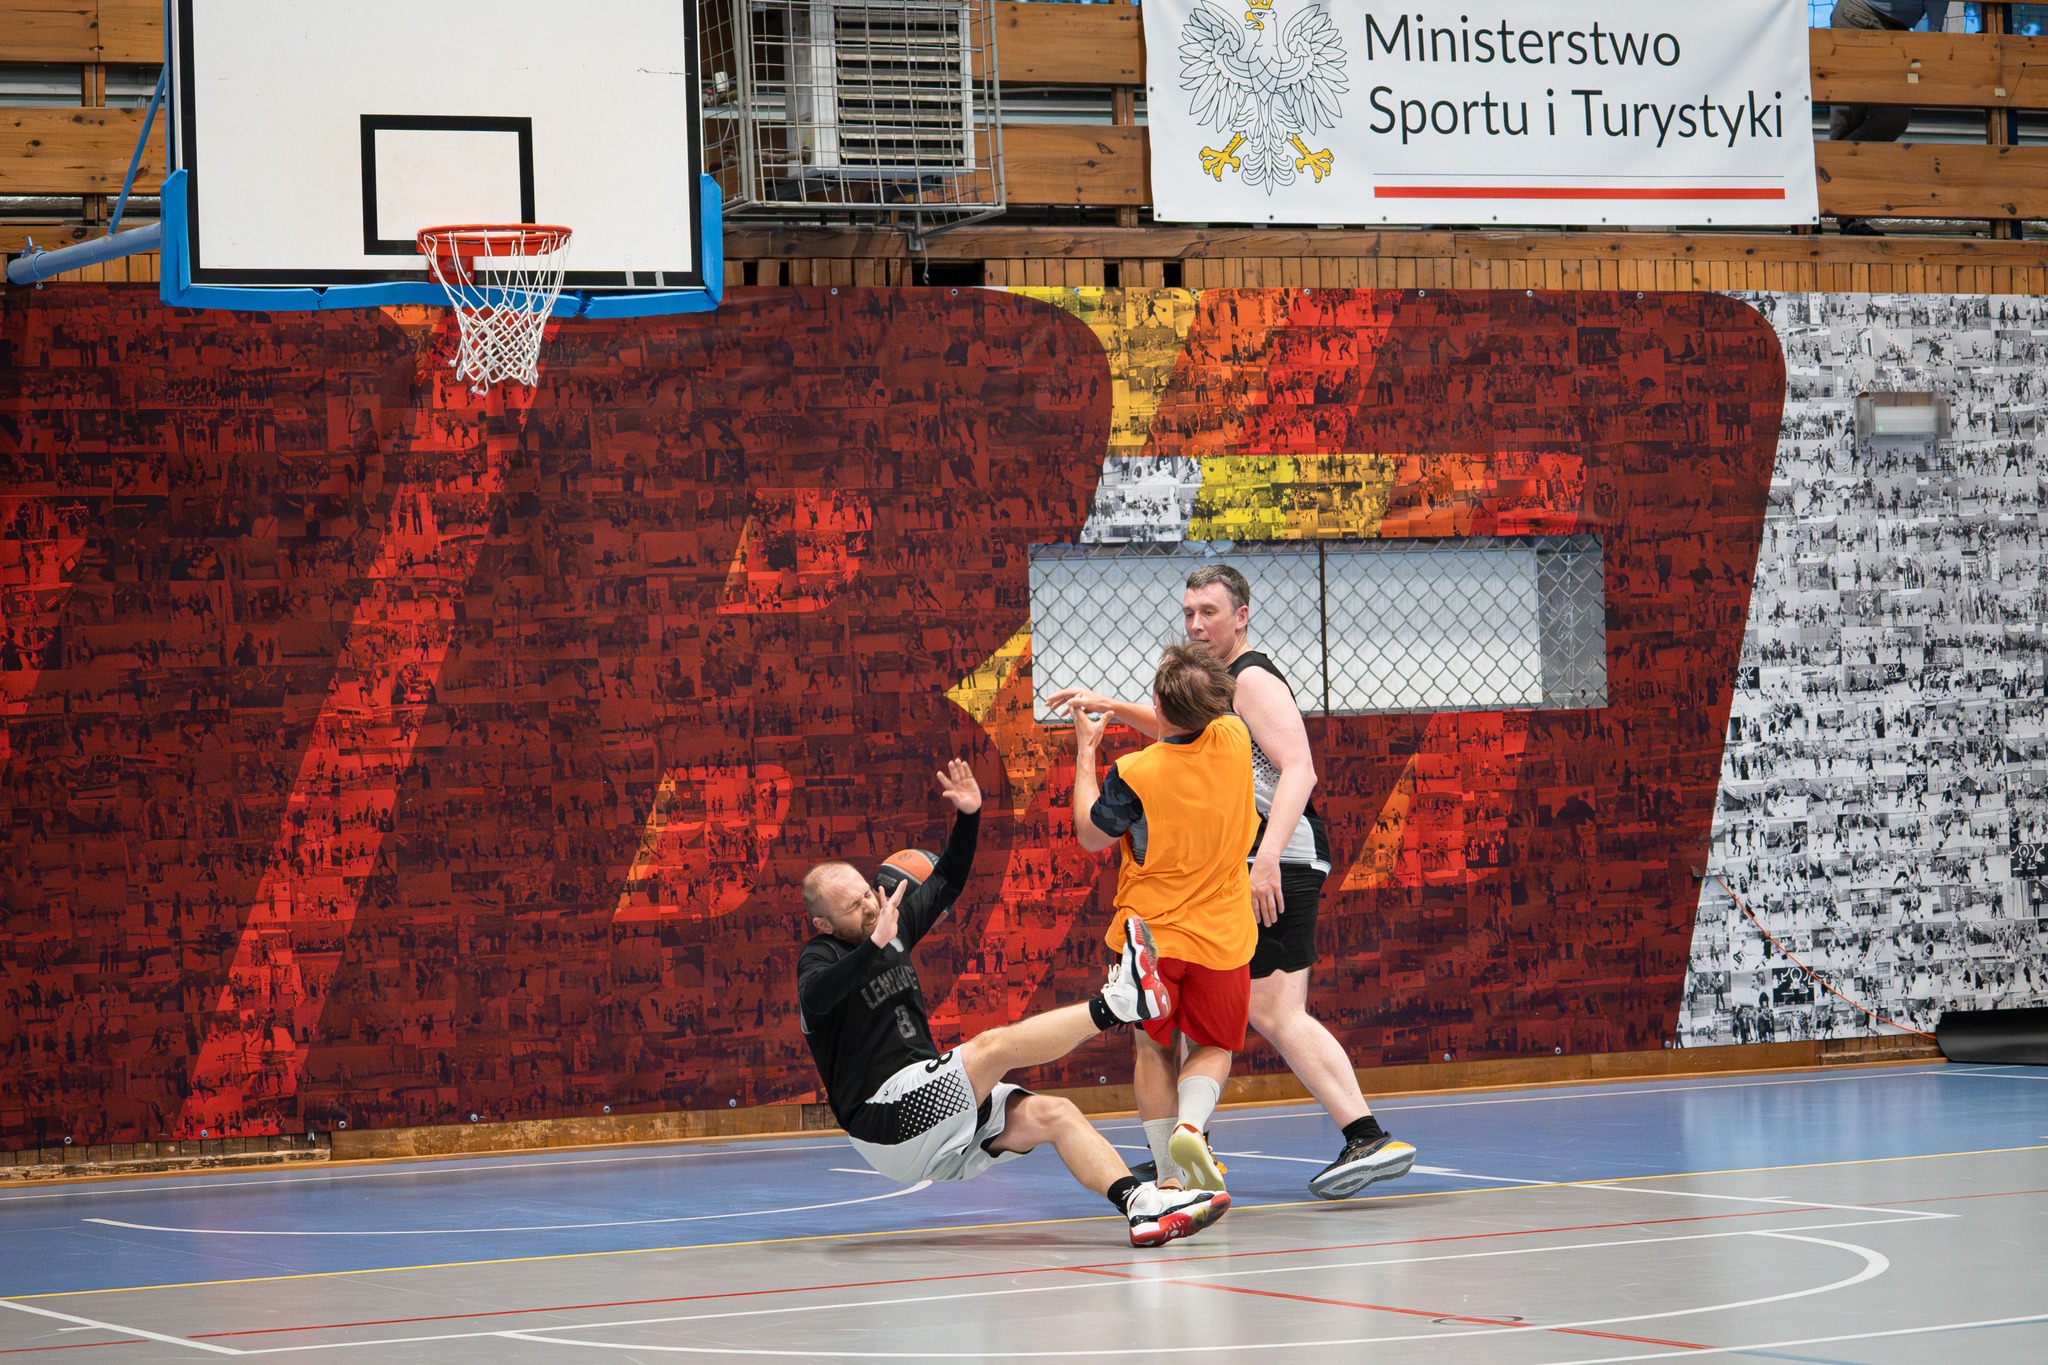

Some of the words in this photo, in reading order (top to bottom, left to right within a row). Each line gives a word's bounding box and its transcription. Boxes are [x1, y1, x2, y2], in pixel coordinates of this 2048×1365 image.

[1366, 14, 1680, 66] Ministerstwo
[1370, 86, 1527, 144] Sportu
[1546, 88, 1556, 136] i
[1572, 90, 1781, 147] Turystyki
[925, 1050, 954, 1074] 8
